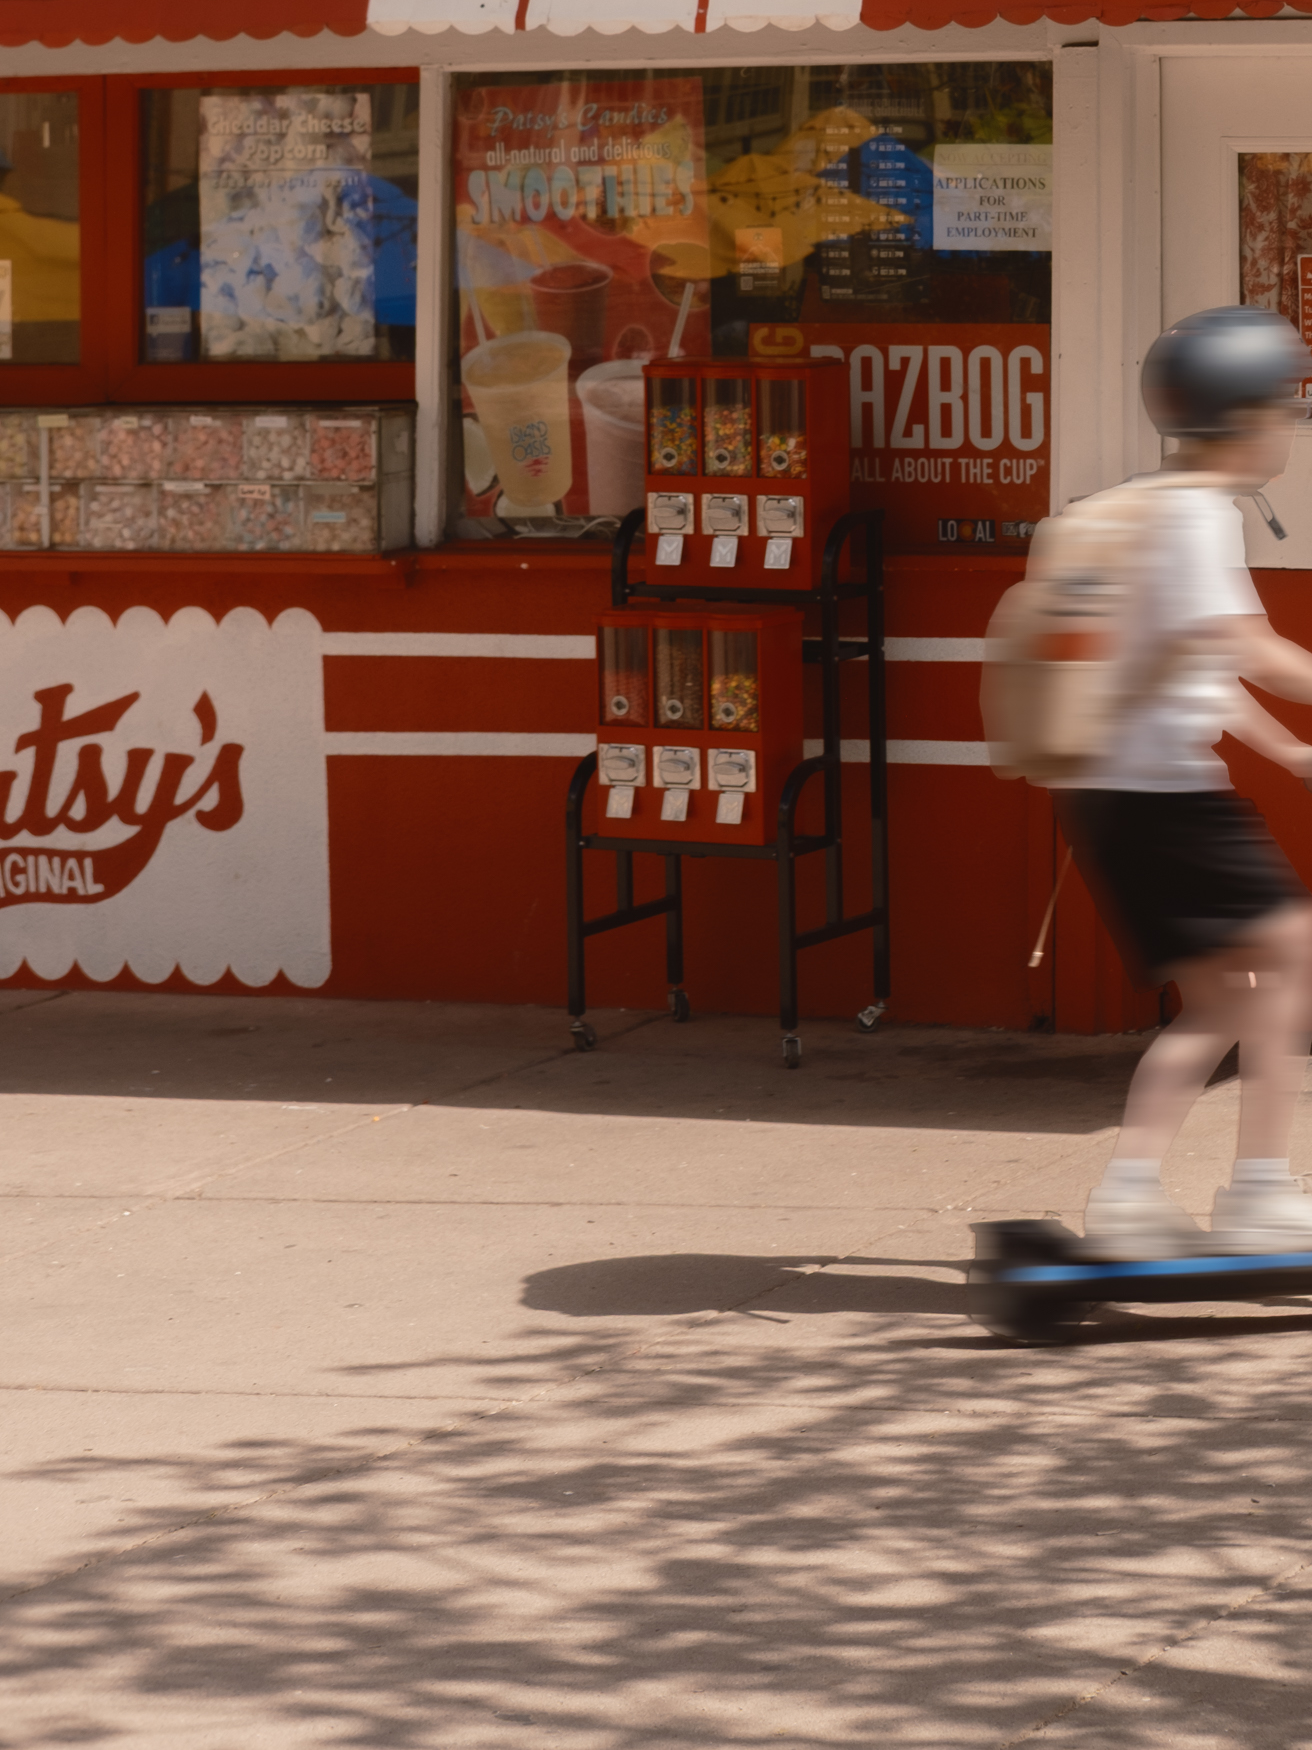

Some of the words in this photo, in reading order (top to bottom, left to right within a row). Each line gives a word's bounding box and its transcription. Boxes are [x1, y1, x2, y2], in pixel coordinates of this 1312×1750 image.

[209, 114, 290, 135] Cheddar
[297, 112, 368, 134] Cheese
[488, 106, 568, 138] Patsy's
[577, 103, 668, 131] Candies
[246, 144, 328, 164] Popcorn
[486, 139, 565, 166] all-natural
[571, 138, 598, 162] and
[604, 136, 671, 160] delicious
[468, 161, 694, 224] SMOOTHIES
[936, 177, 1046, 190] APPLICATIONS
[979, 196, 1006, 206] FOR
[957, 212, 1028, 222] PART-TIME
[947, 227, 1038, 238] EMPLOYMENT
[810, 344, 1045, 451] AZBOG
[512, 437, 551, 462] OASIS
[851, 458, 885, 482] ALL
[892, 458, 953, 483] ABOUT
[958, 458, 993, 483] THE
